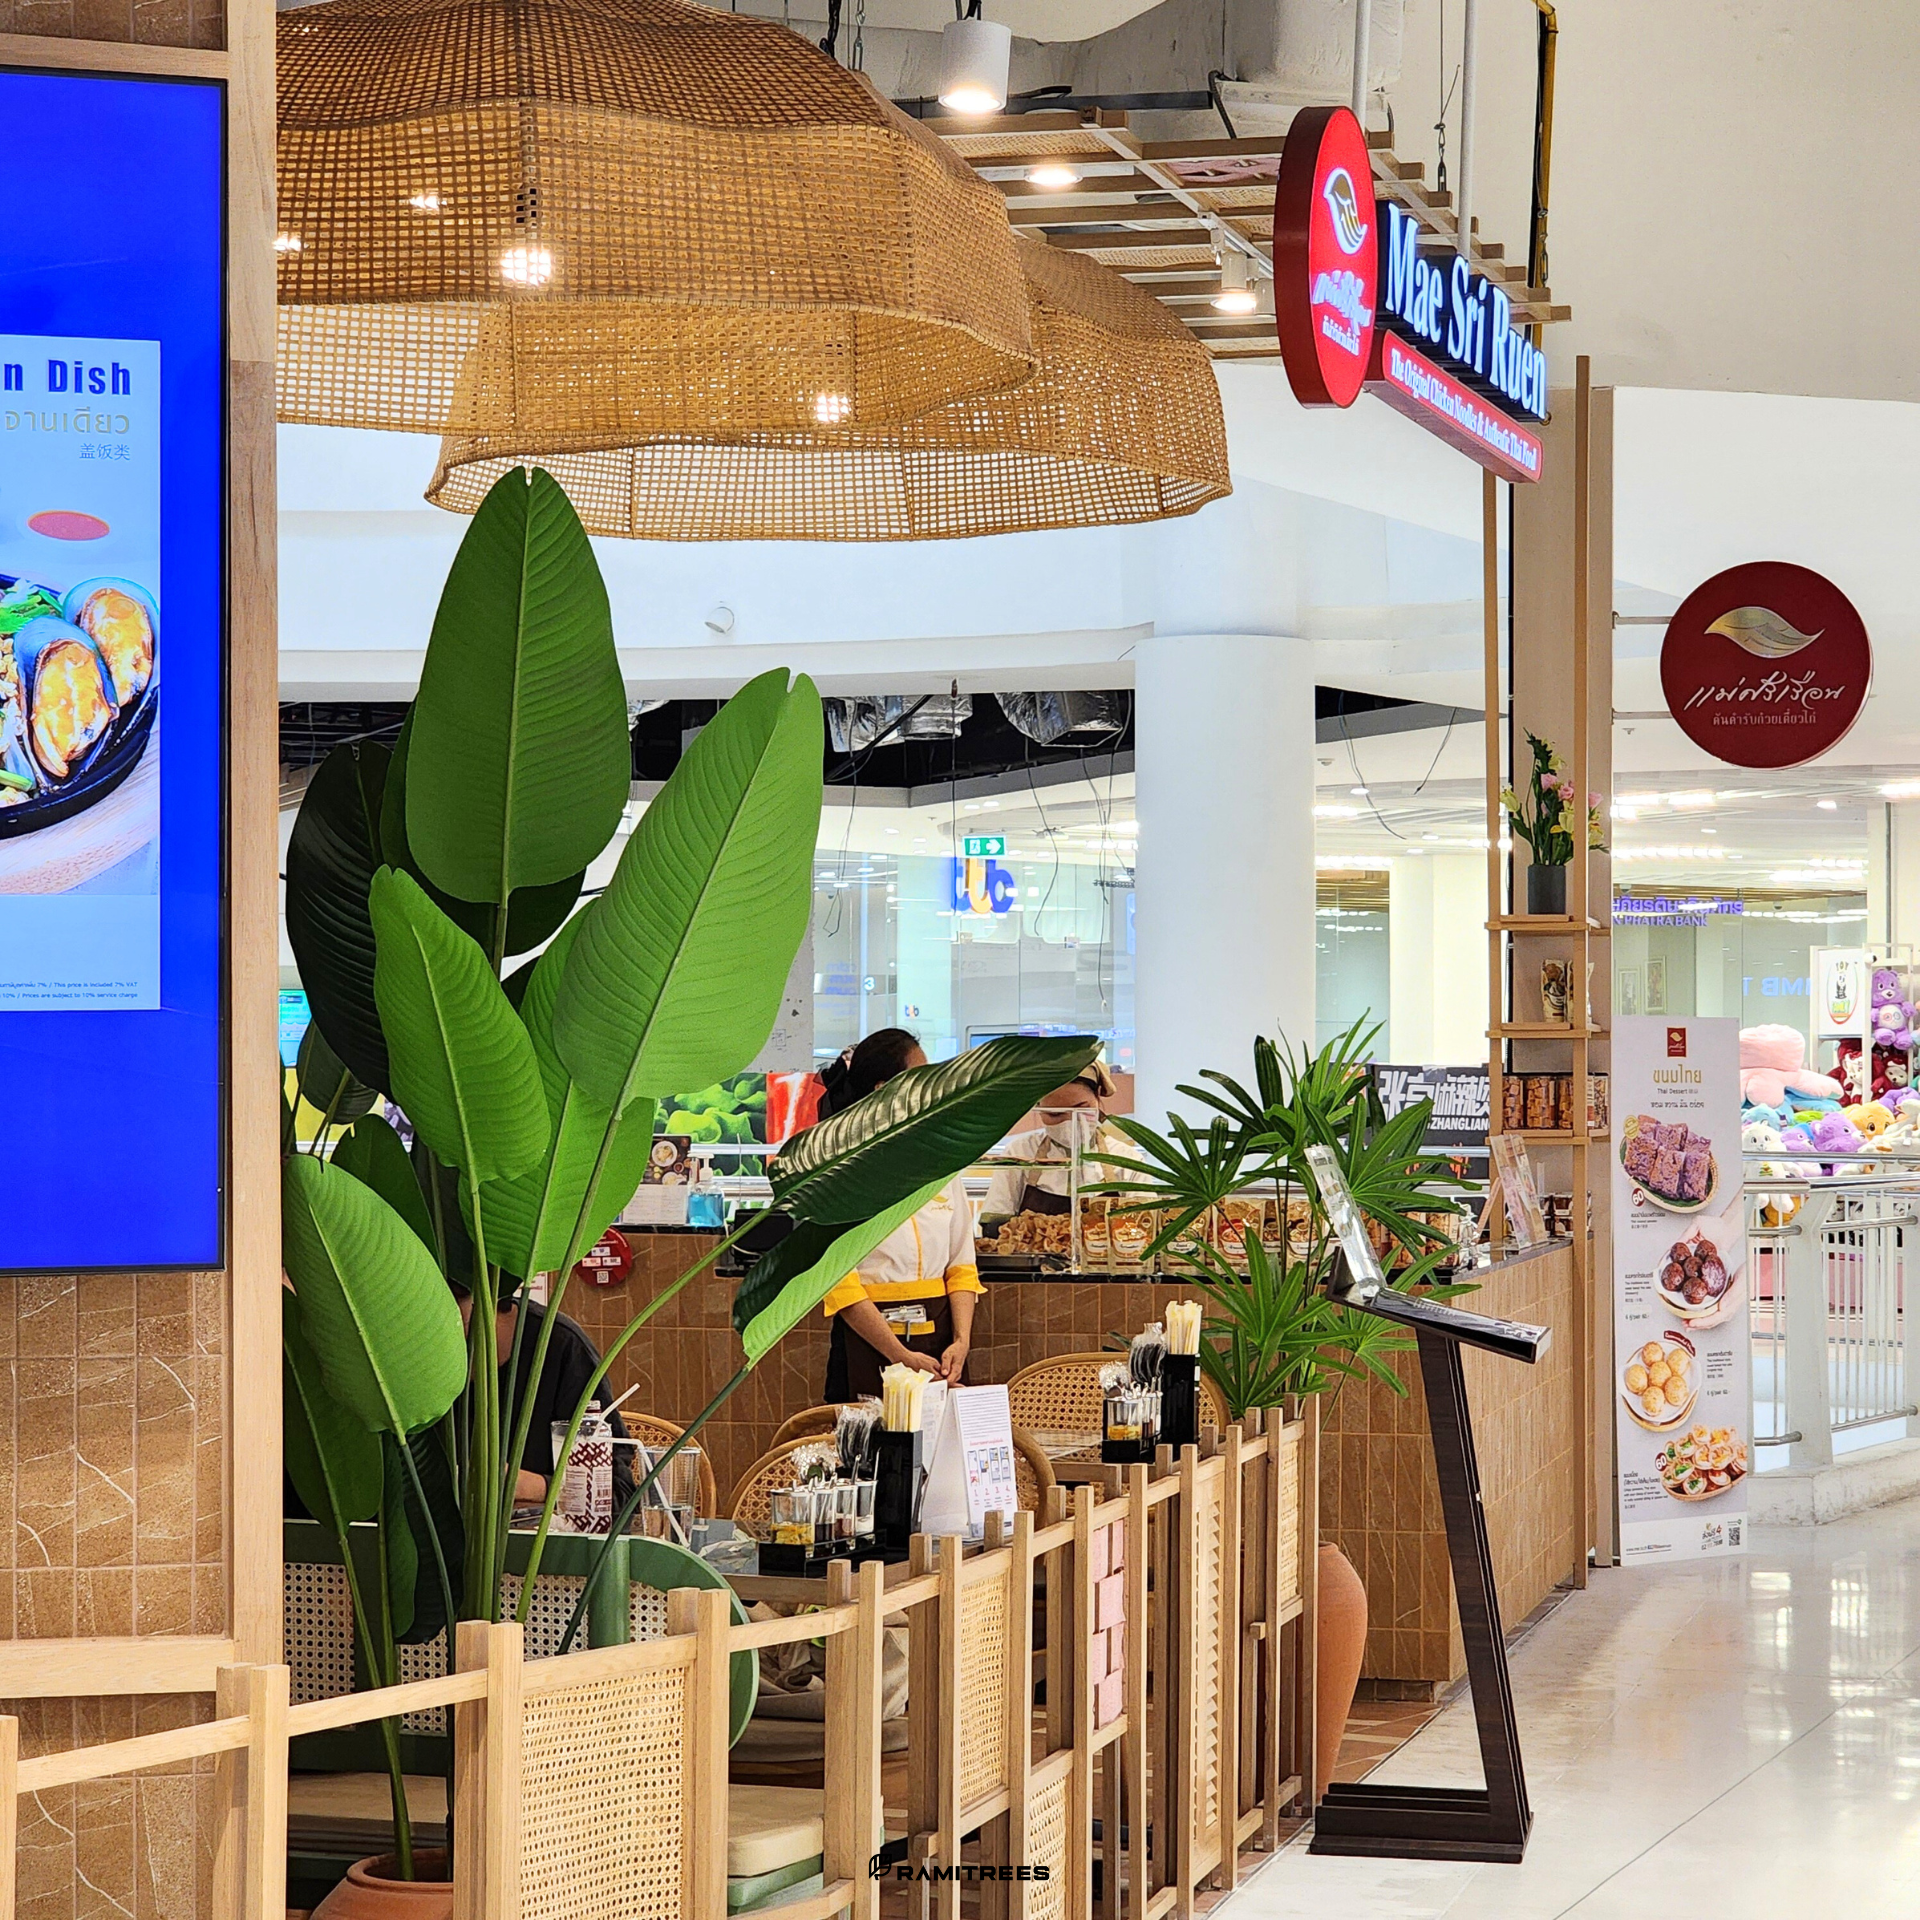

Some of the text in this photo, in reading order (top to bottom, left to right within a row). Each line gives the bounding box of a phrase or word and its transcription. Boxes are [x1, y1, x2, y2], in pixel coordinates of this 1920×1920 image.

[1385, 201, 1546, 419] Mae Sri Ruen
[48, 360, 131, 395] Dish
[1391, 348, 1537, 471] The Original Chicken Noodles & Authentic Thai Food
[5, 406, 130, 434] จานเดียว
[79, 443, 131, 460] 盖饭类
[1683, 670, 1845, 710] แม่ศรีเรือน
[1676, 914, 1708, 927] BANK
[864, 976, 875, 990] 3
[1653, 1064, 1702, 1084] ขนมไทย
[1657, 1087, 1668, 1095] Thai
[1669, 1087, 1688, 1095] Dessert
[1632, 1190, 1644, 1206] 60
[1655, 1454, 1667, 1471] 60
